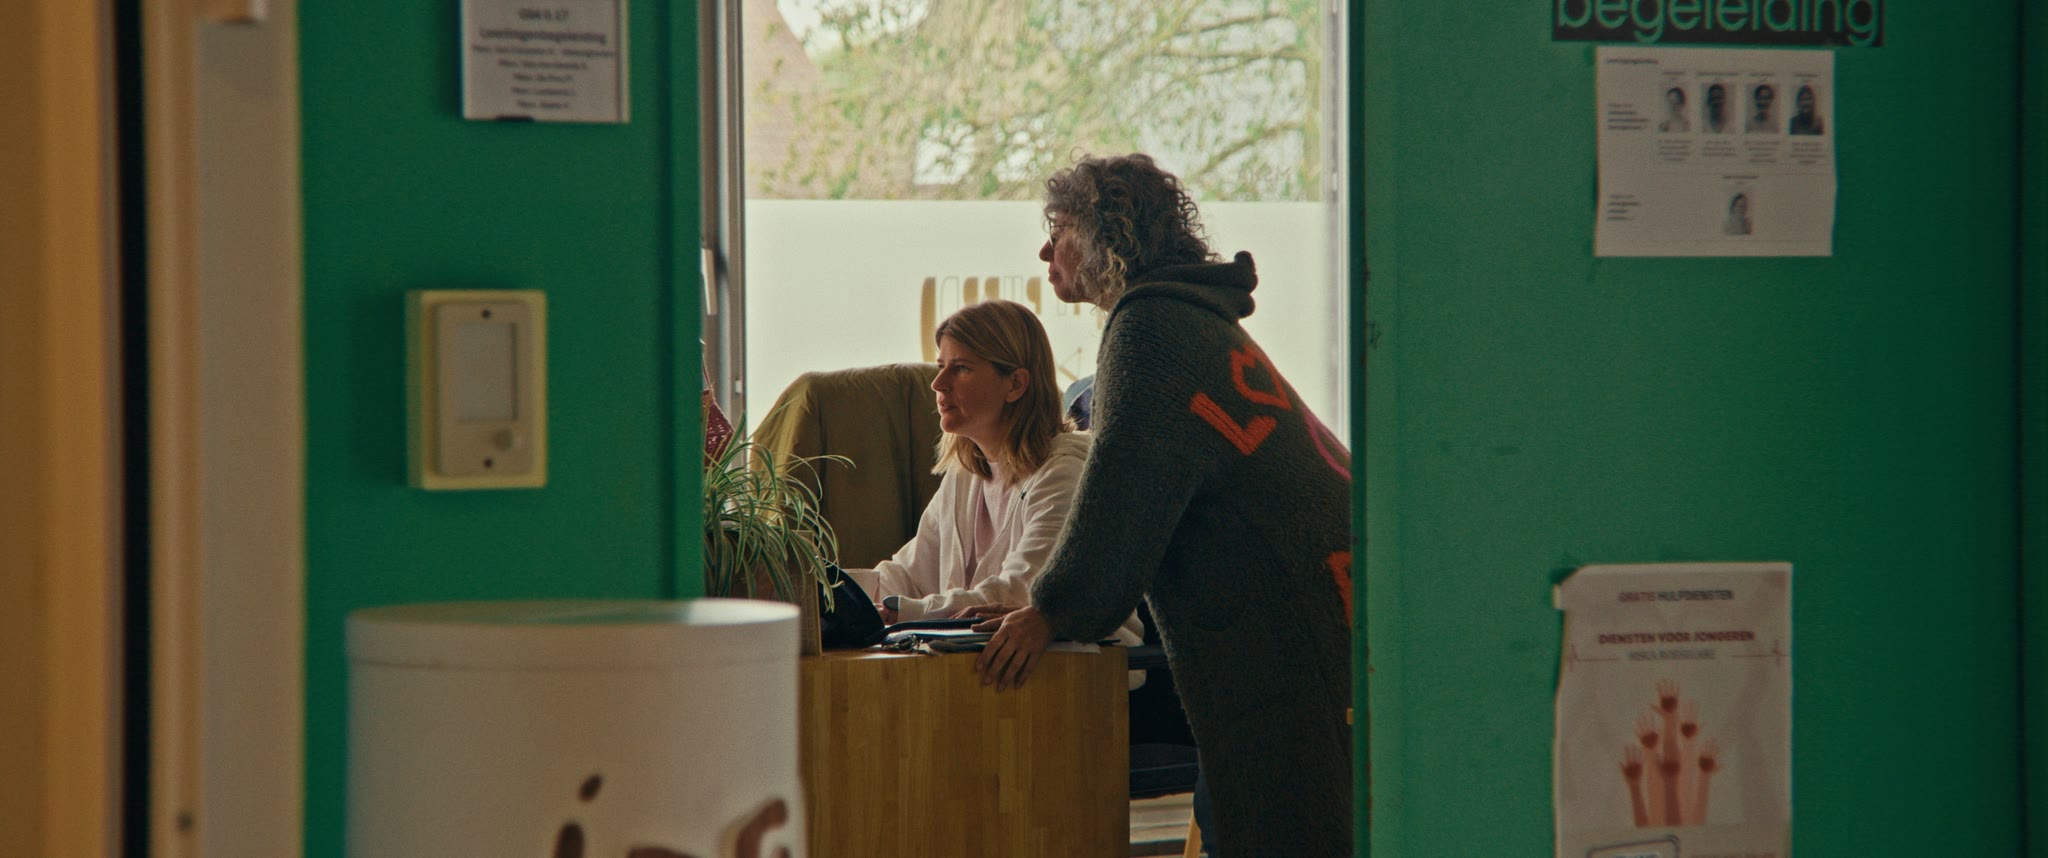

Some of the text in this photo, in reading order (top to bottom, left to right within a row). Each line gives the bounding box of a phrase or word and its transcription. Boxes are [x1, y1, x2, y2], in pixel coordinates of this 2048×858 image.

[1558, 0, 1880, 46] begeleiding
[1618, 591, 1656, 603] GRATIS
[1598, 630, 1756, 645] DIENSTEN VOOR JONGEREN
